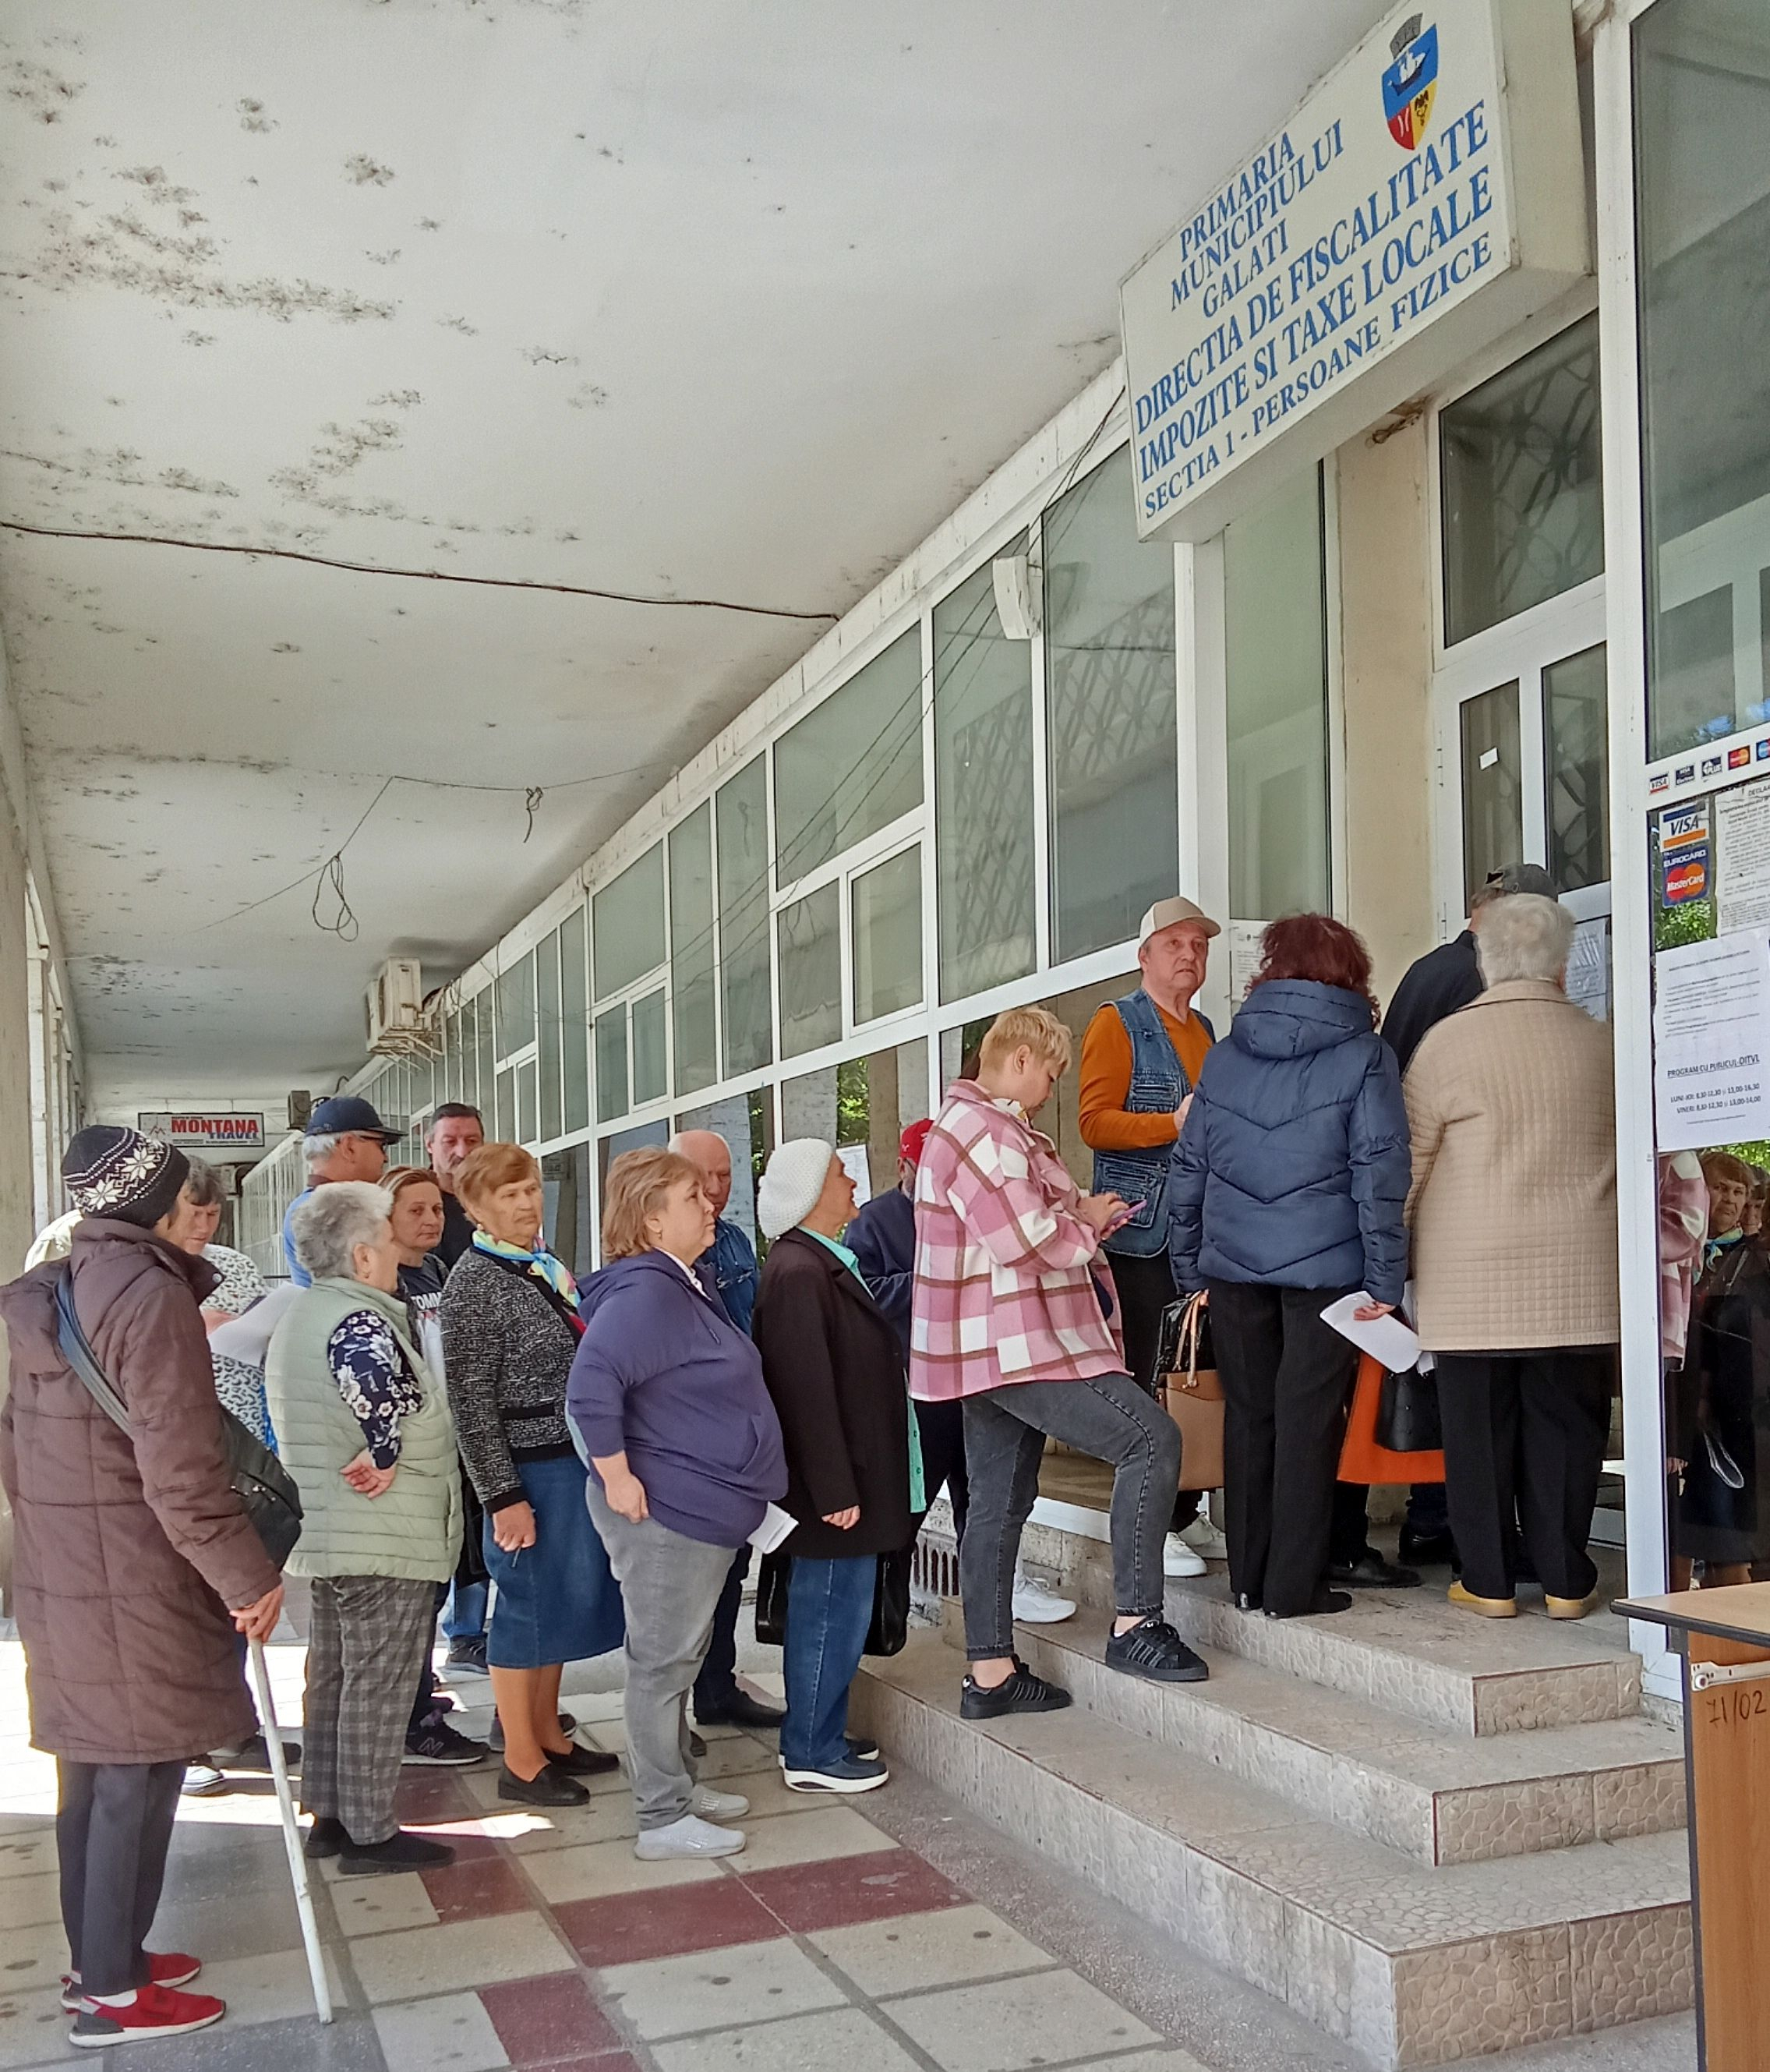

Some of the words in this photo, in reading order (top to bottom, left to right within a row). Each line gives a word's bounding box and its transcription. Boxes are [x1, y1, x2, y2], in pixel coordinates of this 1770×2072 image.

[1171, 119, 1344, 311] MUNICIPIULUI
[1179, 132, 1295, 262] PRIMARIA
[1136, 313, 1245, 435] DIRECTIA
[1248, 276, 1283, 339] DE
[1289, 100, 1489, 305] FISCALITATE
[1203, 219, 1289, 318] GALATI
[1140, 362, 1249, 483] IMPOZITE
[1254, 337, 1277, 392] SI
[1282, 278, 1357, 366] TAXE
[1362, 166, 1493, 305] LOCALE
[1145, 450, 1221, 519] SECTIA
[1226, 430, 1235, 457] 1
[1252, 316, 1381, 437] PERSOANE
[1391, 232, 1493, 332] FIZICE
[1664, 849, 1706, 868] EUROCARD
[1670, 814, 1699, 836] VISA
[1667, 873, 1705, 891] MasterCard
[1668, 1065, 1699, 1077] PROGRAM
[1700, 1063, 1708, 1073] CU
[171, 1119, 259, 1133] MONTANA
